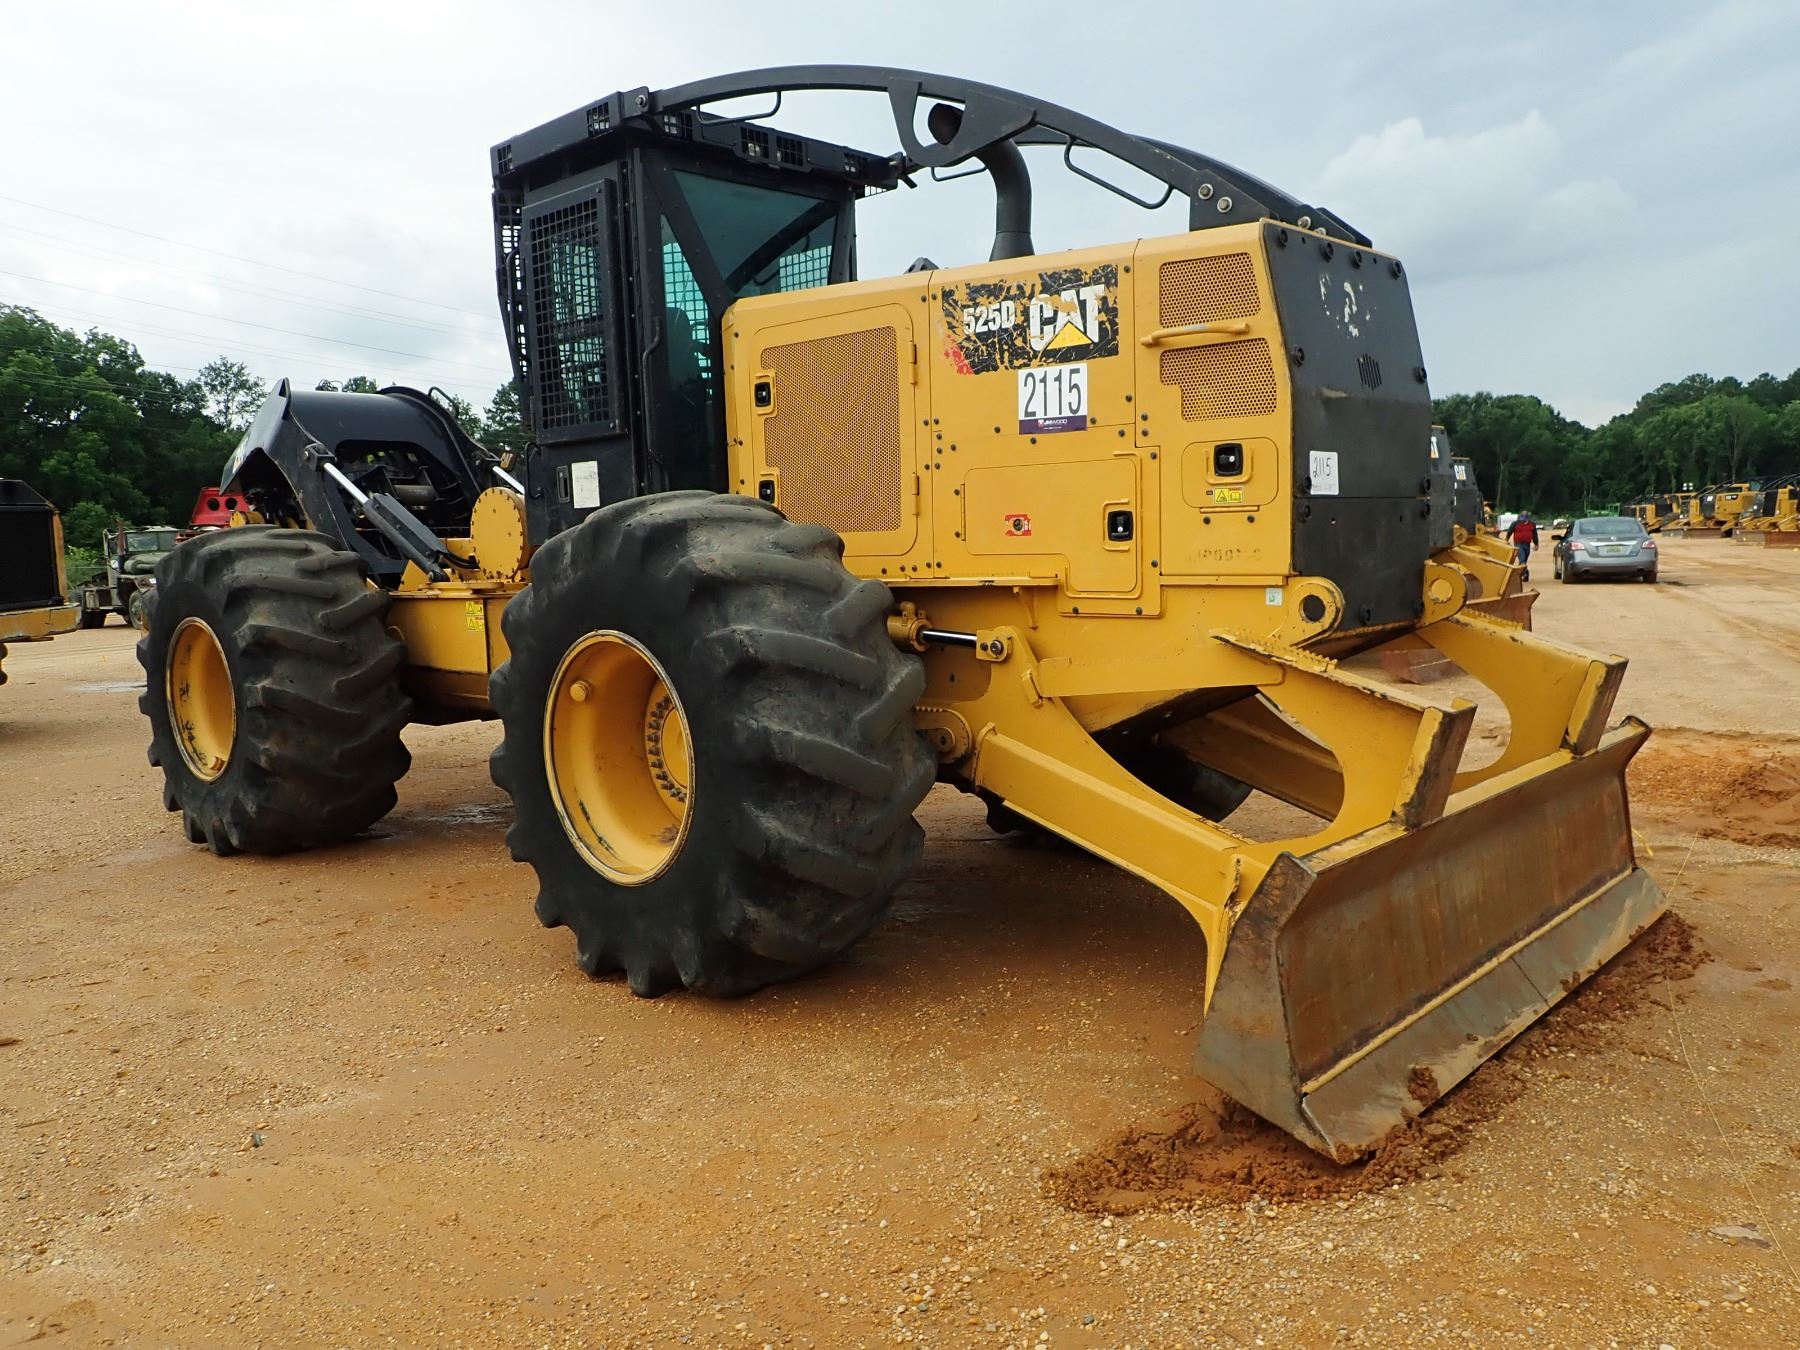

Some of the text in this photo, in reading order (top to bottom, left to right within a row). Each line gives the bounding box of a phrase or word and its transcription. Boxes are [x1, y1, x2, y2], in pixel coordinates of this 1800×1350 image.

[963, 301, 1016, 335] 525D
[1029, 284, 1105, 351] CAT
[1024, 368, 1081, 418] 2115
[1313, 456, 1332, 478] 2115
